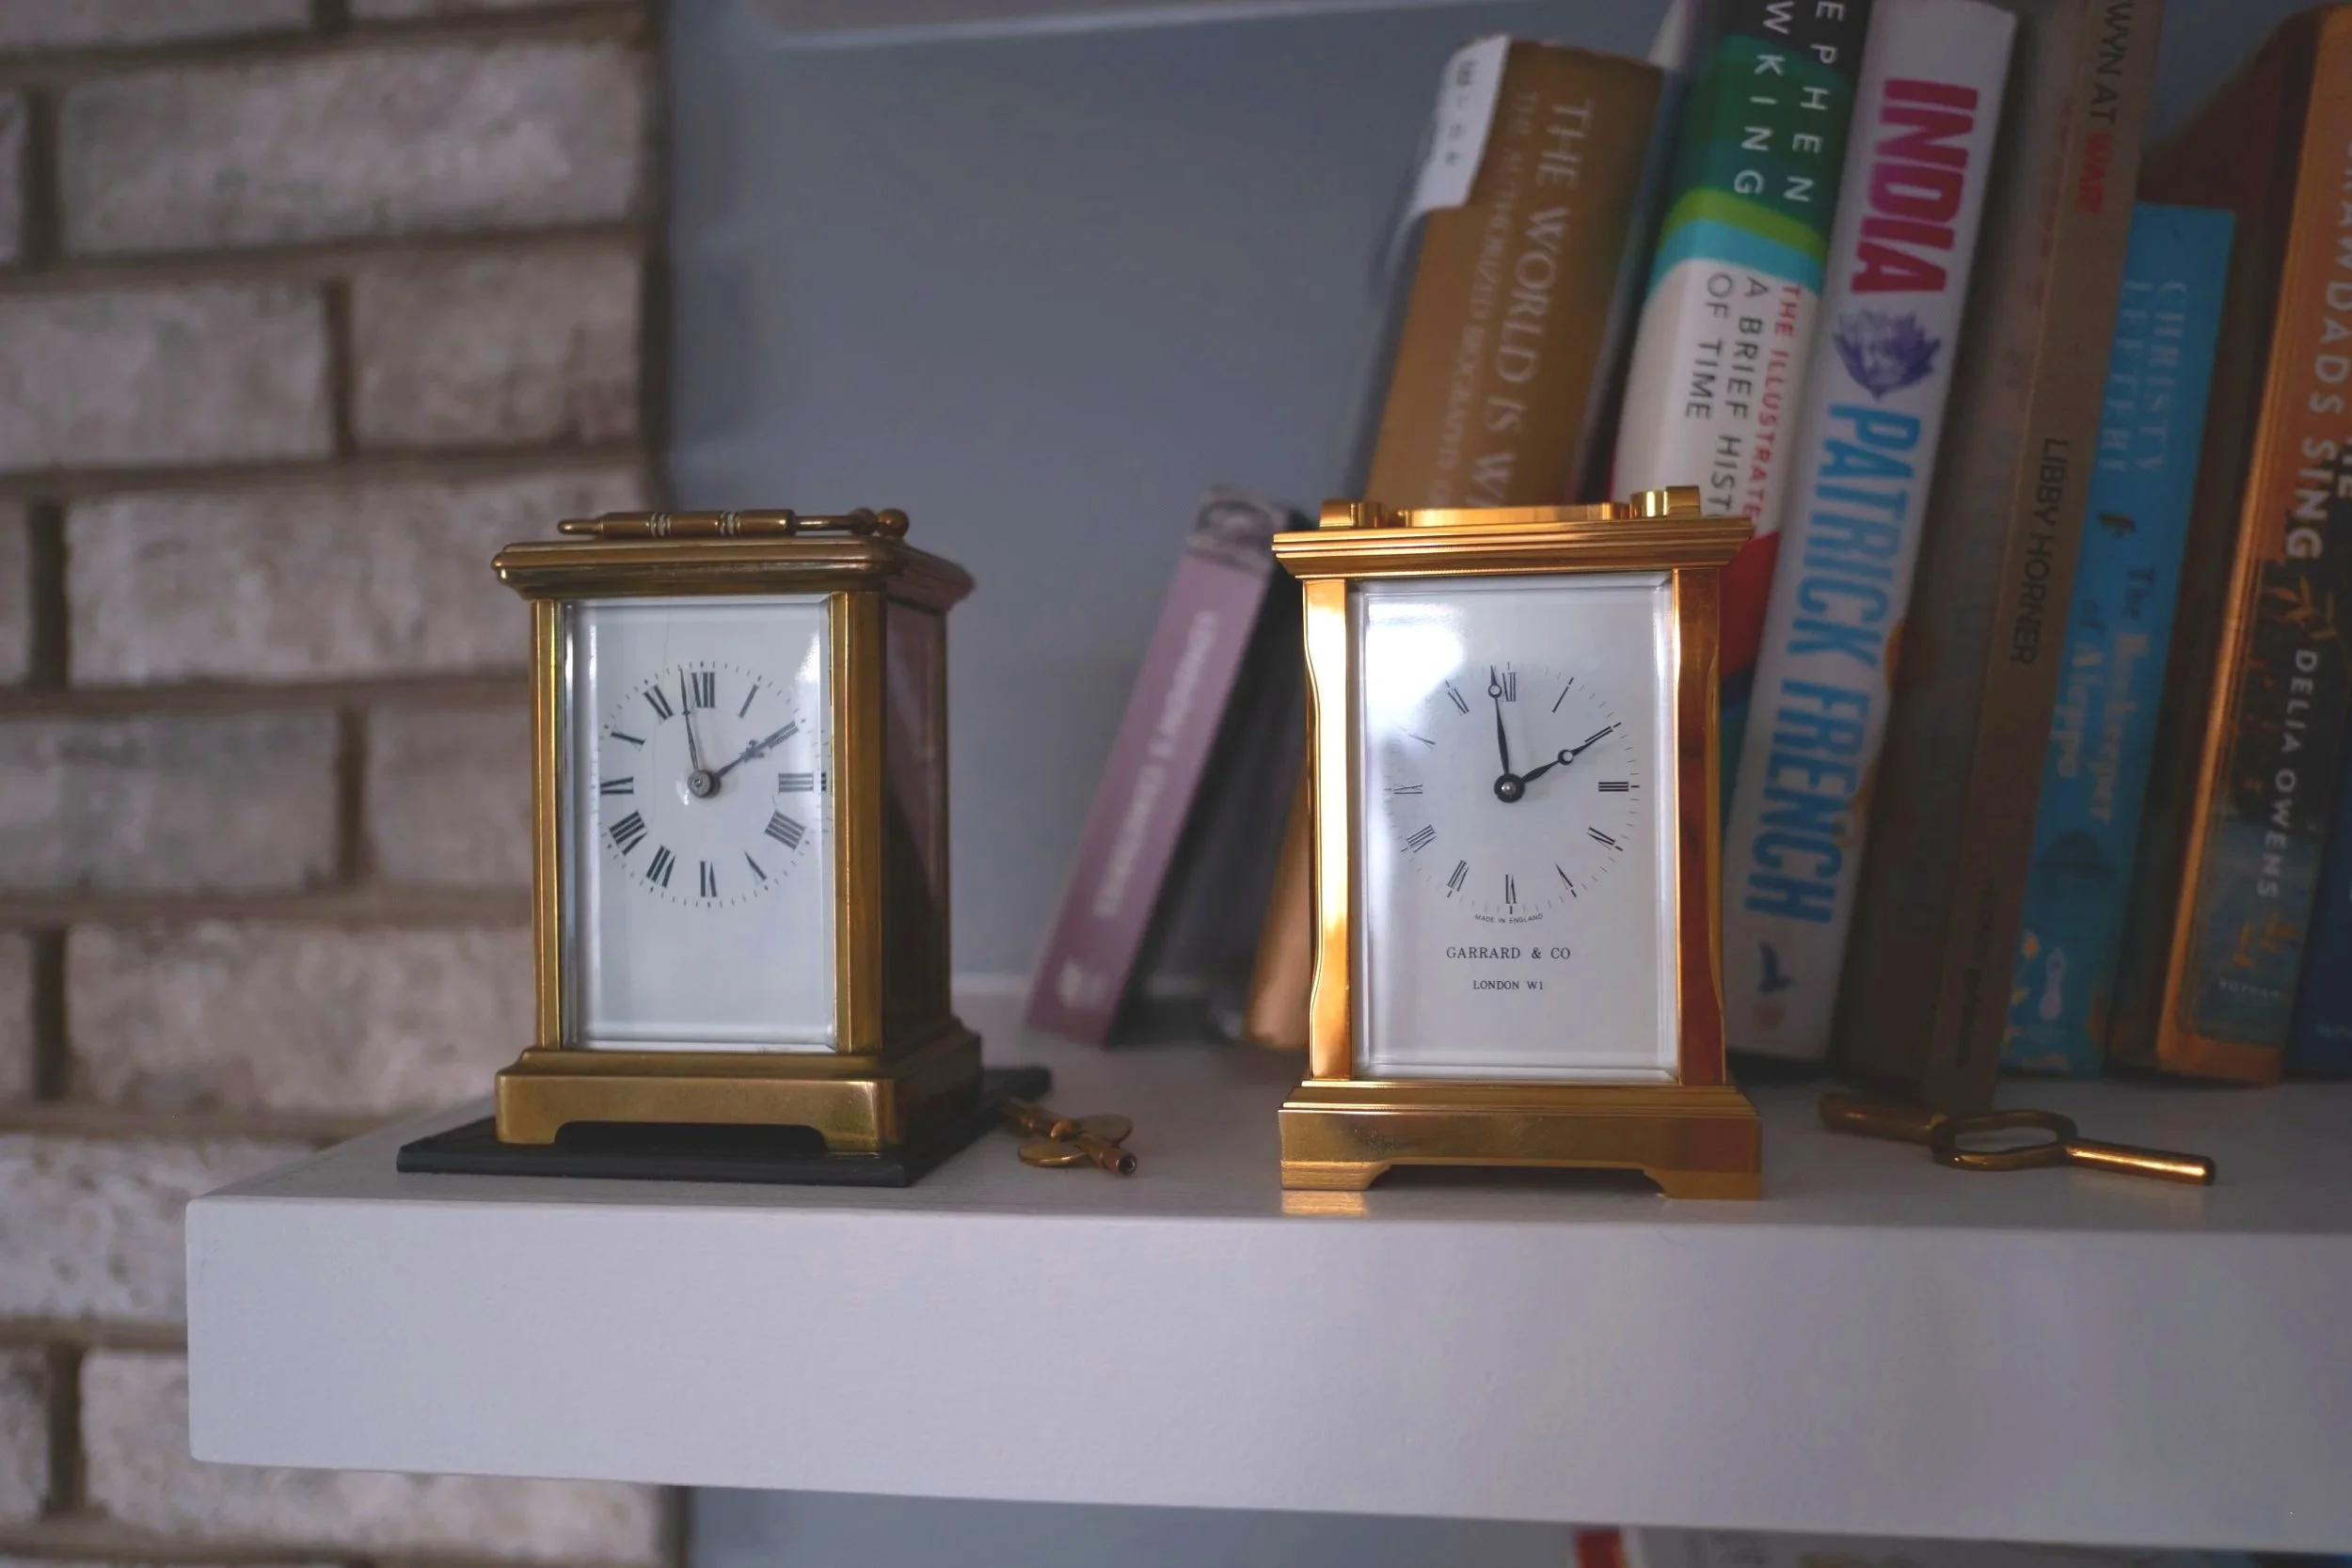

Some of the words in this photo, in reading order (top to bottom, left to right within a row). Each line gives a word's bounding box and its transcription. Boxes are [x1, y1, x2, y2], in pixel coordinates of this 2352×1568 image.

[2096, 0, 2134, 75] WYN
[1535, 97, 1596, 187] THE
[1734, 1, 1794, 194] WKING
[1782, 1, 1846, 203] EPHEN
[2090, 83, 2120, 123] AT
[1851, 78, 1979, 293] INDIA
[2075, 130, 2114, 214] WAR
[1496, 206, 1572, 383] WORLD
[1705, 273, 1734, 320] OF
[1743, 277, 1771, 297] A
[1774, 285, 1802, 337] THE
[1685, 339, 1723, 420] TIME
[1725, 315, 1764, 420] BRIEF
[2134, 279, 2188, 473] CHRISTY
[1484, 395, 1527, 434] IS
[1707, 434, 1741, 516] HIST
[2033, 437, 2070, 527] LIBBY
[2285, 436, 2338, 559] SING
[1787, 403, 1922, 666] PATRICK
[2010, 532, 2056, 665] HORNER
[2280, 649, 2317, 752] DELIA
[1743, 679, 1872, 924] FRENCH
[2256, 768, 2297, 898] OWENS
[1446, 946, 1521, 959] GARRARD
[1531, 946, 1542, 959] &
[1550, 947, 1571, 959] CO
[1474, 913, 1494, 924] MADE
[1509, 911, 1544, 925] ENGLAND
[1473, 980, 1519, 990] LONDON
[1527, 980, 1544, 990] W1
